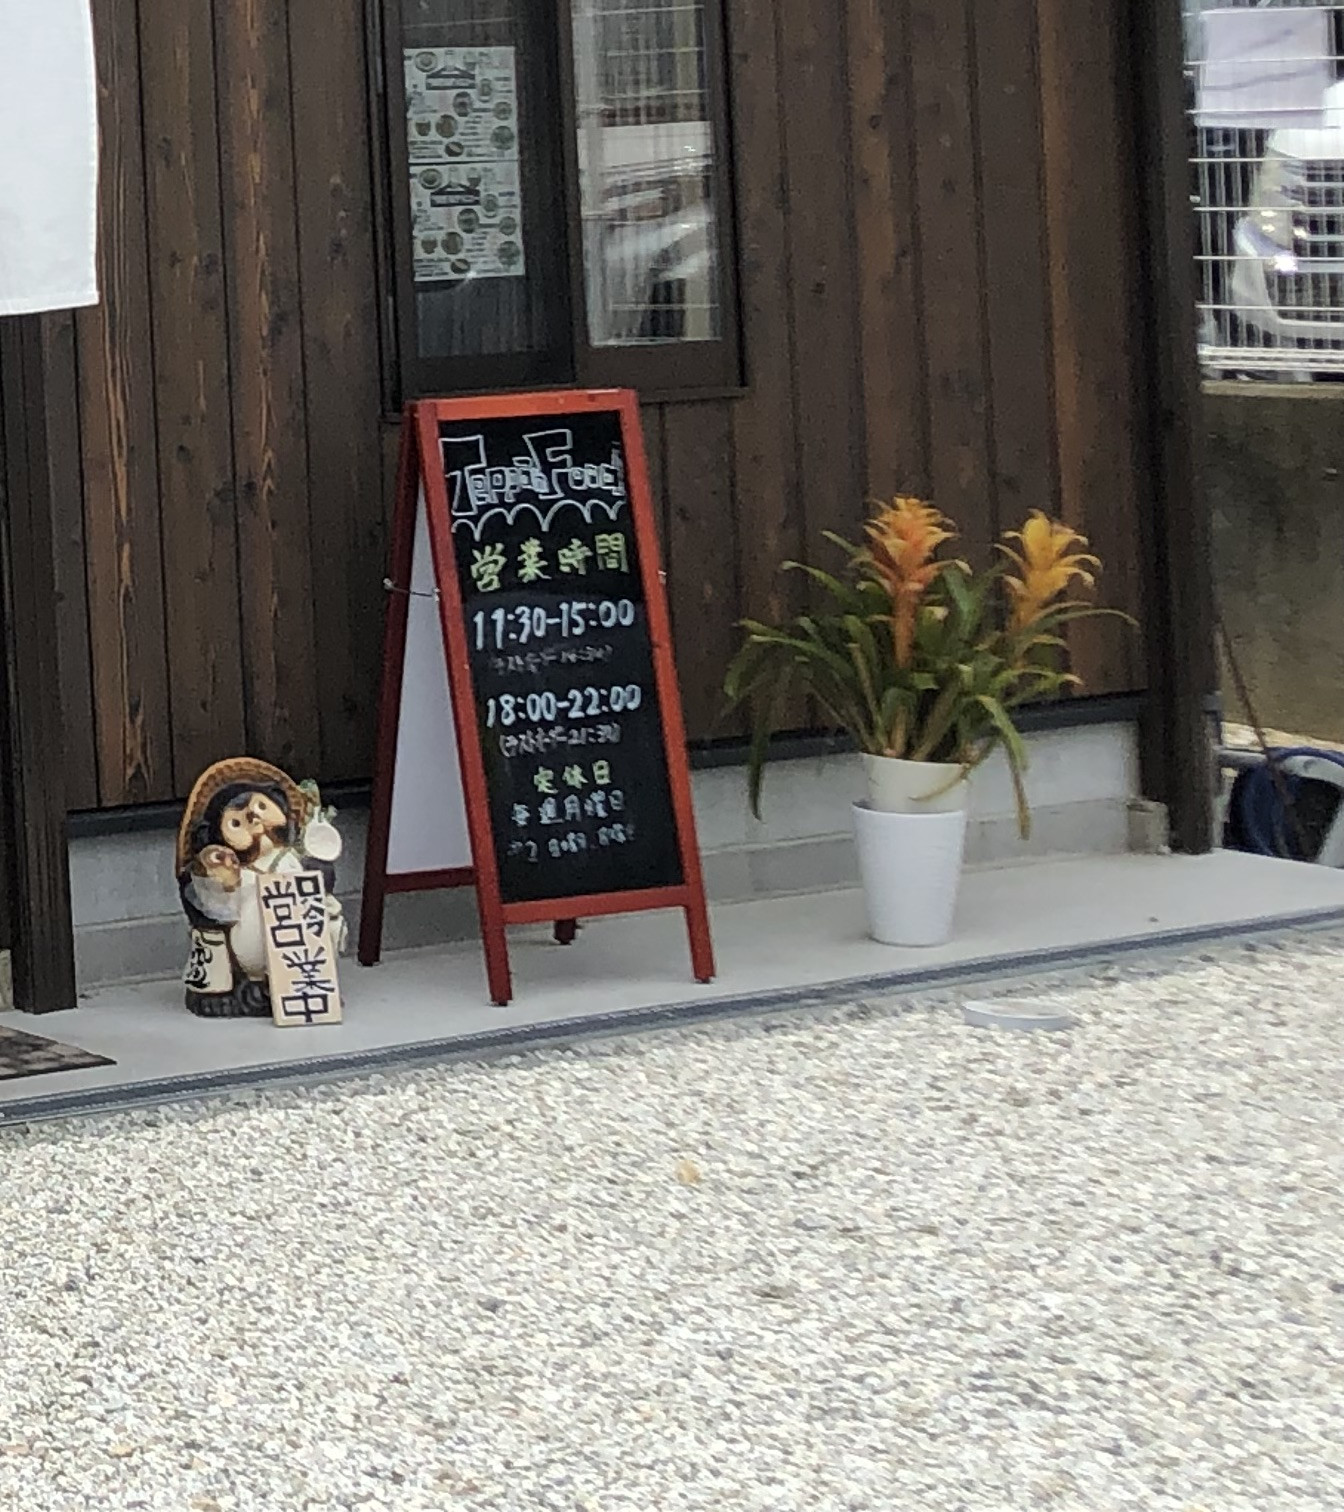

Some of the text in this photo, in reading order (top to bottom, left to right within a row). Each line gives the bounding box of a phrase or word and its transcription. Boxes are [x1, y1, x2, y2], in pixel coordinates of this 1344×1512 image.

[470, 532, 629, 592] 営業時間
[534, 760, 611, 794] 定休日
